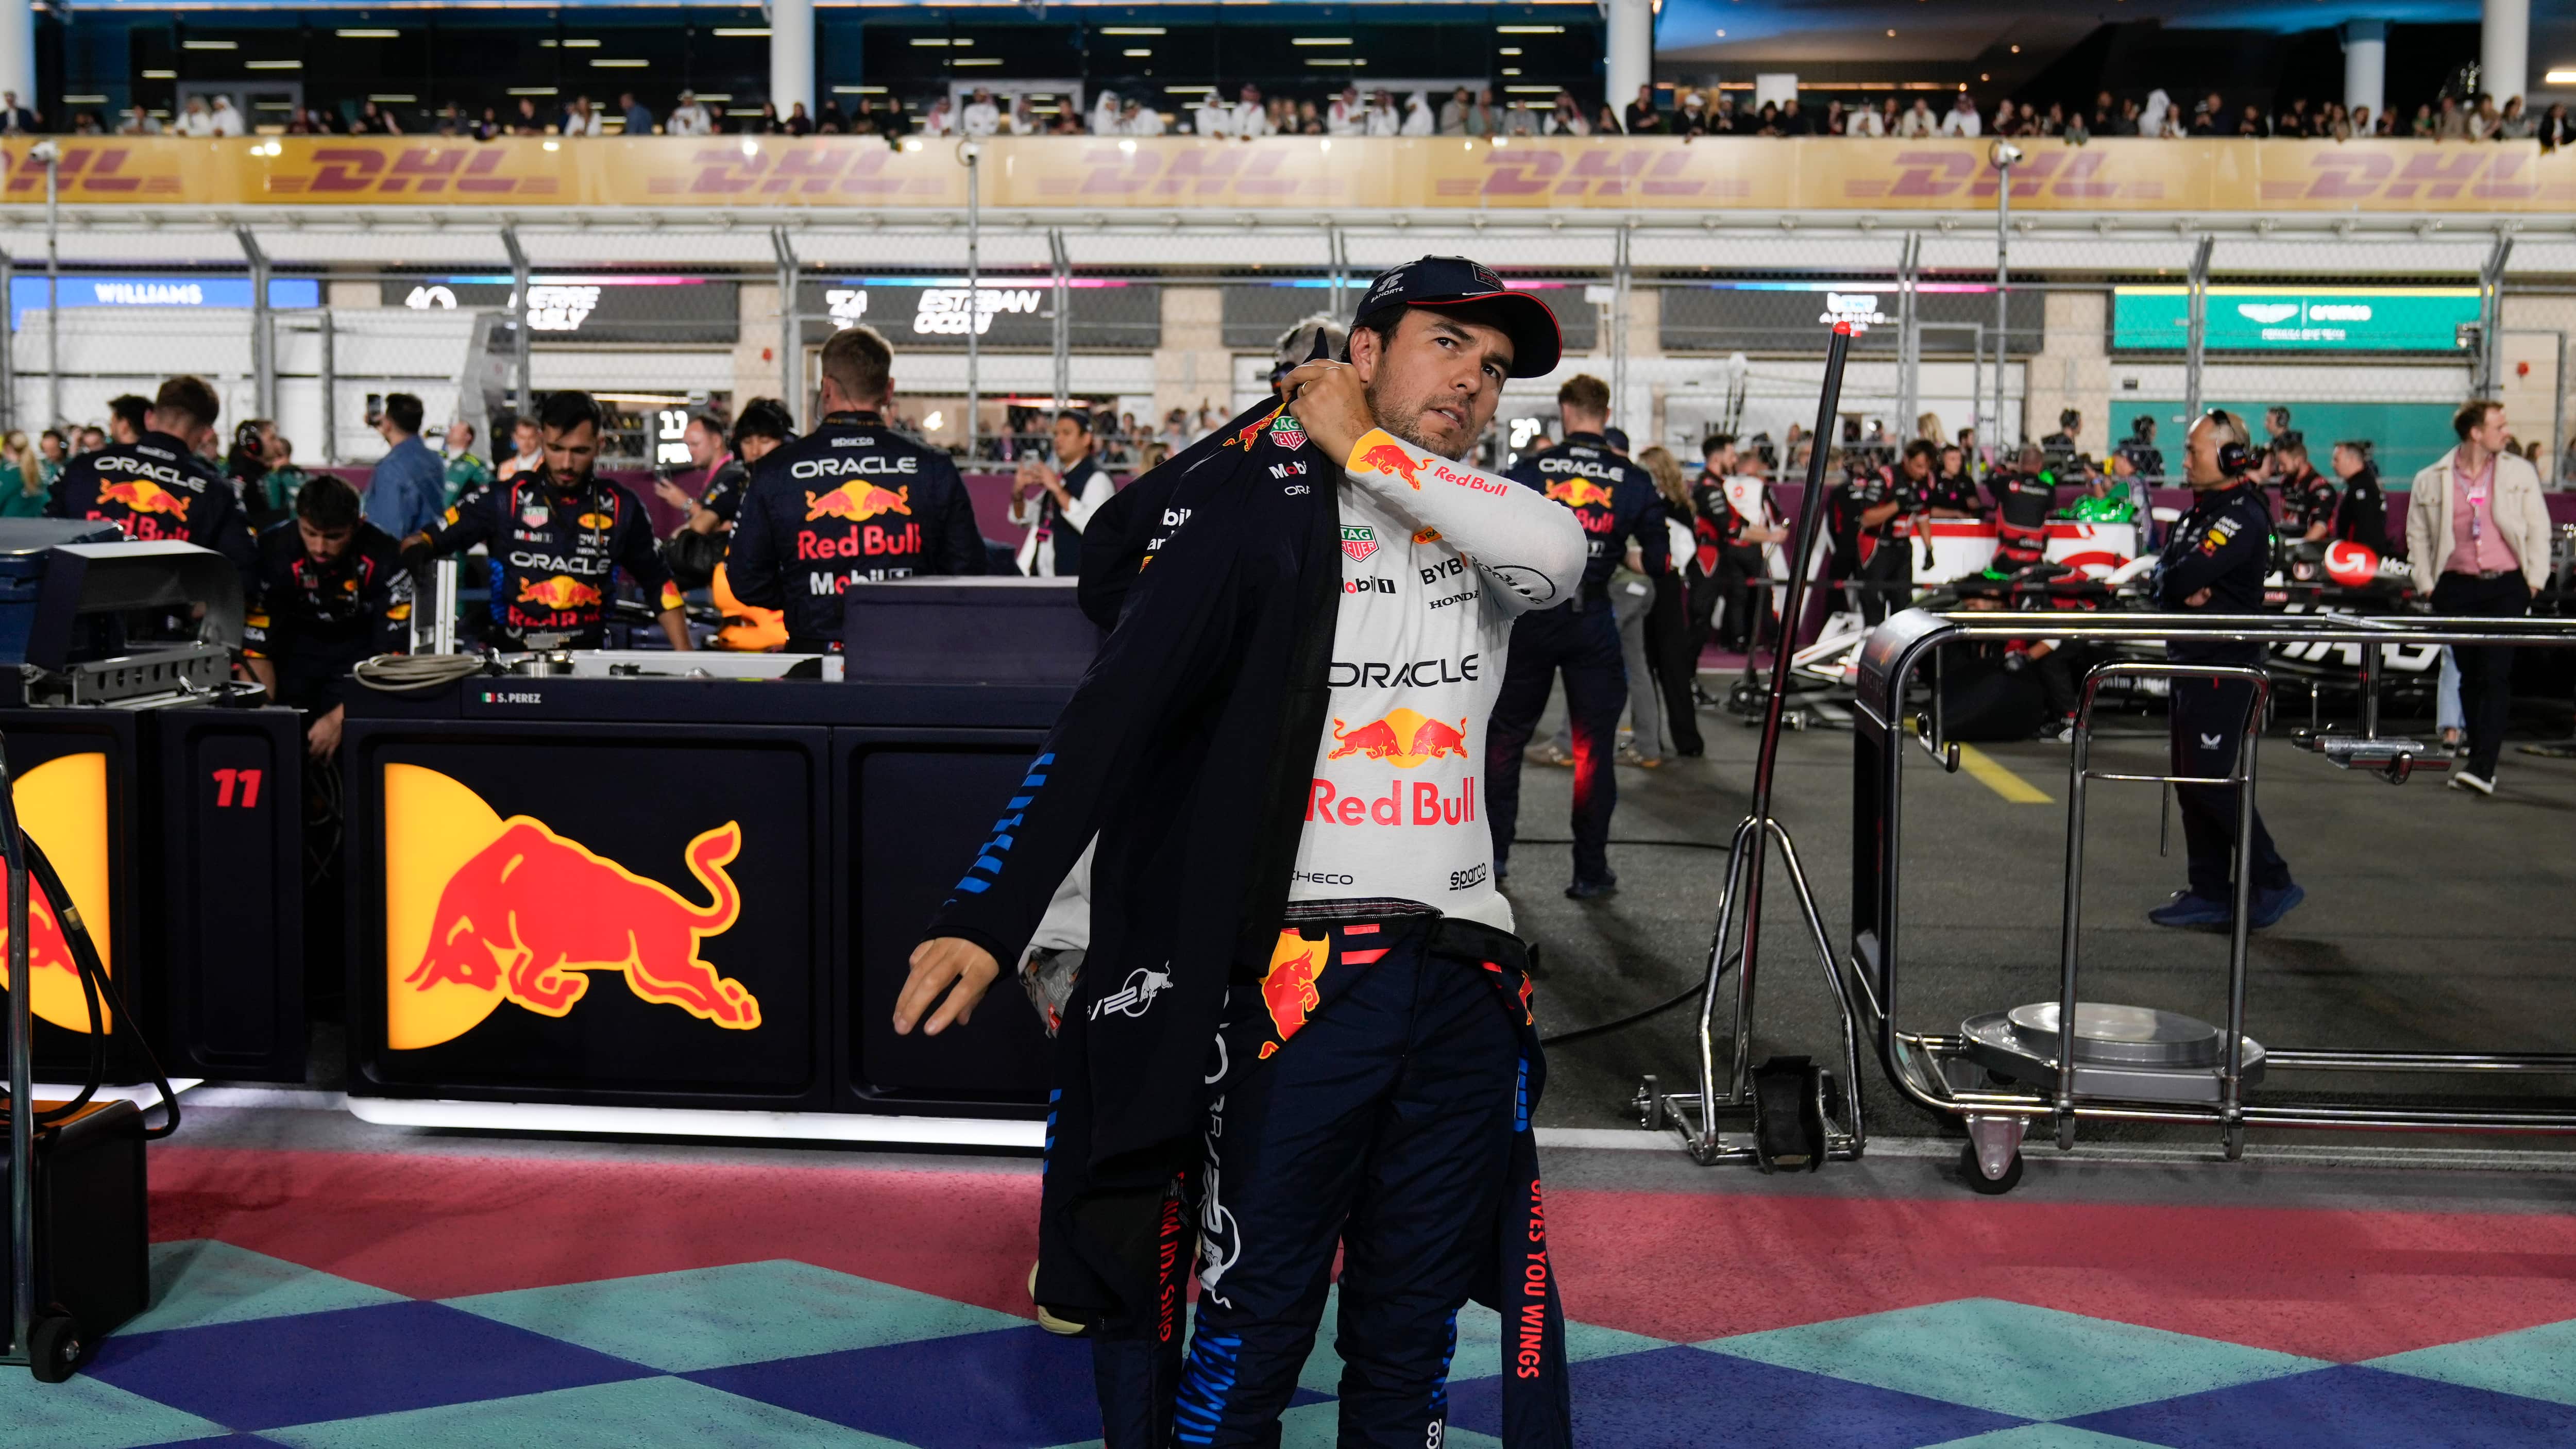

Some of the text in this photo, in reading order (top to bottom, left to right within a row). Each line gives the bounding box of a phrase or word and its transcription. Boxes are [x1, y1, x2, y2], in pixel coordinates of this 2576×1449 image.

[310, 149, 517, 192] DHL
[690, 150, 903, 193] DHL
[1080, 150, 1299, 194] DHL
[1481, 151, 1705, 195] DHL
[1889, 151, 2116, 197] DHL
[2306, 152, 2541, 199] DHL
[94, 283, 203, 305] WILLIAMS
[918, 289, 1041, 313] ESTEBAN
[1274, 431, 1303, 447] HEUER
[94, 456, 208, 493] ORACLE
[791, 456, 919, 479] ORACLE
[1434, 465, 1508, 497] Red Bull
[1538, 458, 1625, 482] ORACLE
[514, 529, 543, 543] Mobil
[798, 522, 922, 560] Red Bull
[1340, 528, 1371, 540] TAG
[1341, 542, 1375, 559] HEUER
[509, 550, 612, 576] ORACLE
[1328, 653, 1479, 688] ORACLE
[497, 693, 541, 704] S. PEREZ
[212, 768, 262, 808] 11
[1305, 776, 1475, 826] Red Bull
[1449, 862, 1487, 891] sparco
[1159, 1240, 1178, 1285] YOU
[1523, 1251, 1546, 1296] YOU
[1158, 1284, 1175, 1342] GIVES
[1516, 1304, 1545, 1379] WINGS
